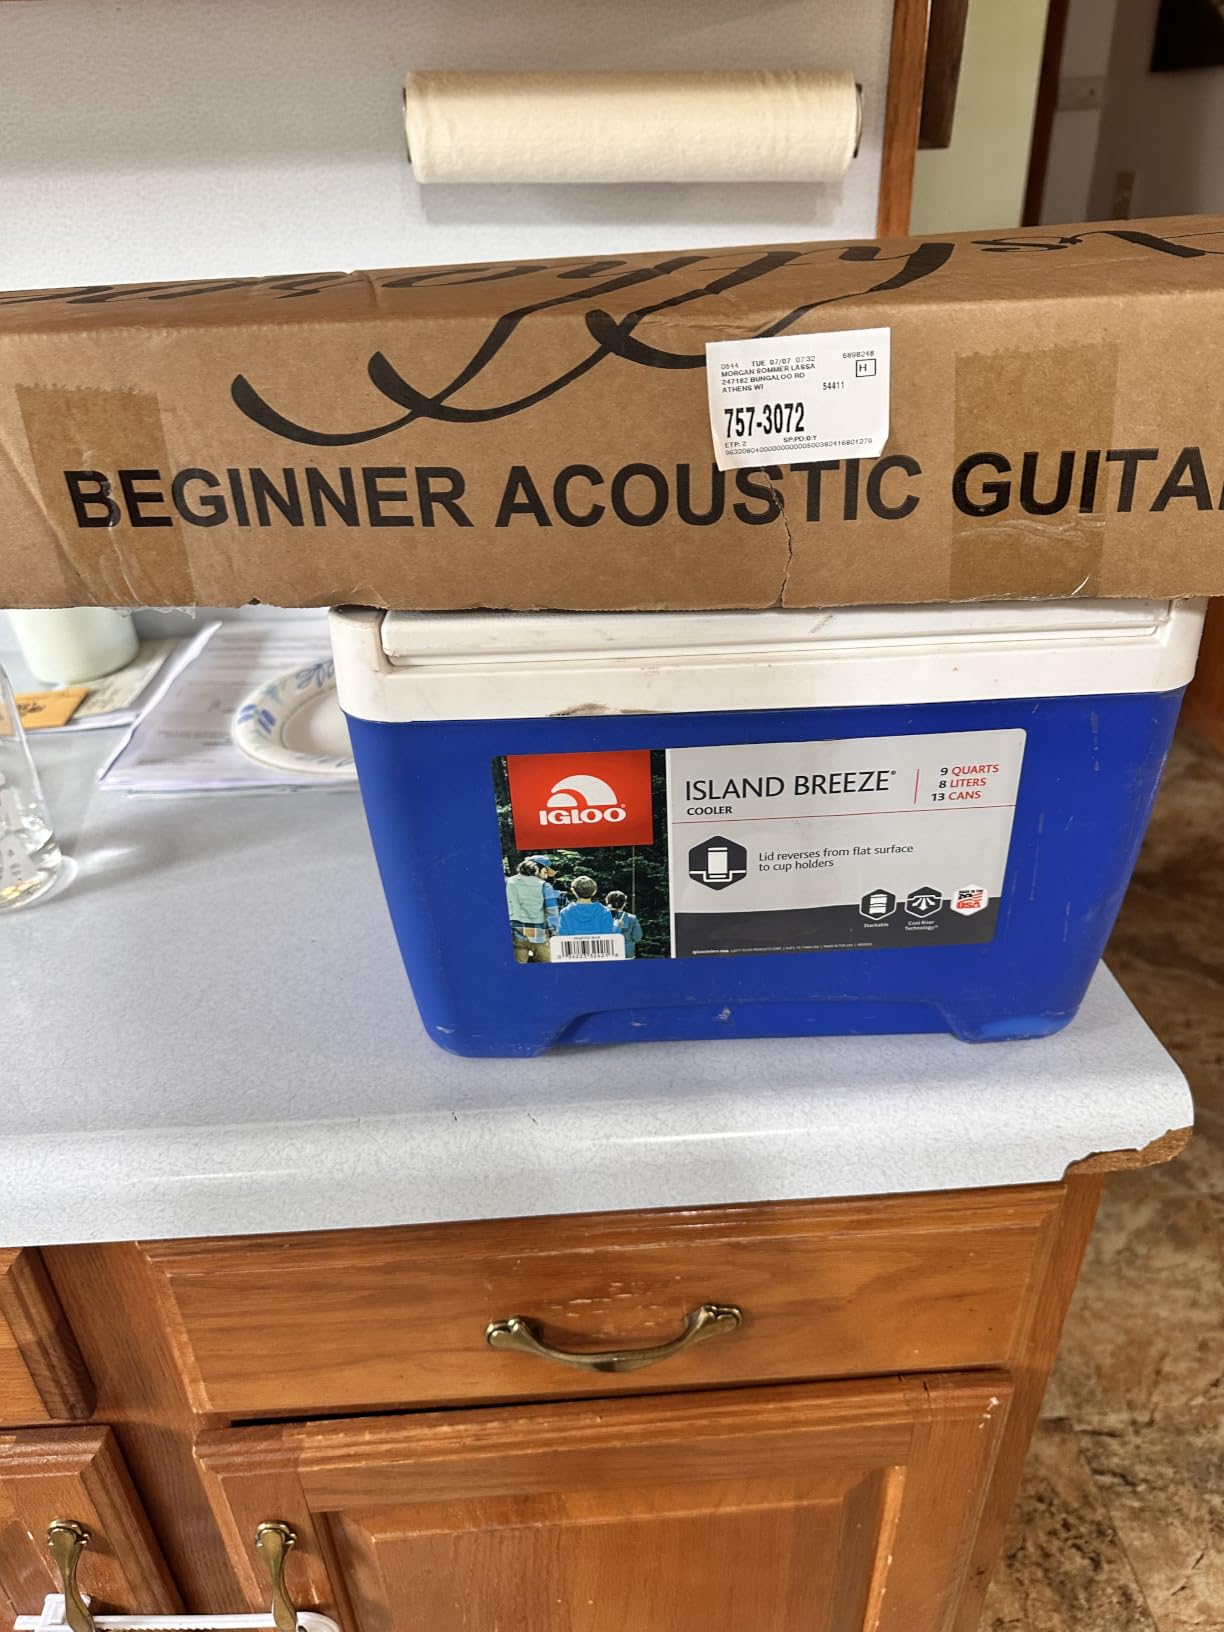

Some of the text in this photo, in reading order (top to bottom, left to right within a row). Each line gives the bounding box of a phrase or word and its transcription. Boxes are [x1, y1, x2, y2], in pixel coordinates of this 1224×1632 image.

[751, 360, 766, 368] TUE
[858, 363, 868, 372] H
[720, 363, 816, 378] MORGAN SOMMER LASSA
[750, 373, 794, 383] BUNGALOO
[794, 372, 806, 380] RD
[722, 384, 752, 394] ATHENS
[822, 381, 845, 390] 54411
[724, 402, 805, 438] 757-3072
[63, 446, 1224, 528] BEGINNER ACOUSTIC GUITA
[940, 764, 1000, 776] 9 QUARTS
[686, 776, 784, 801] ISLAND
[938, 777, 987, 789] 8 LITERS
[931, 790, 982, 802] 13 CANS
[539, 807, 627, 826] IGLOO
[686, 806, 733, 816] COOLER
[758, 844, 914, 862] Lid reverses from flat surface
[758, 858, 834, 874] to cup holders
[956, 900, 981, 909] USA
